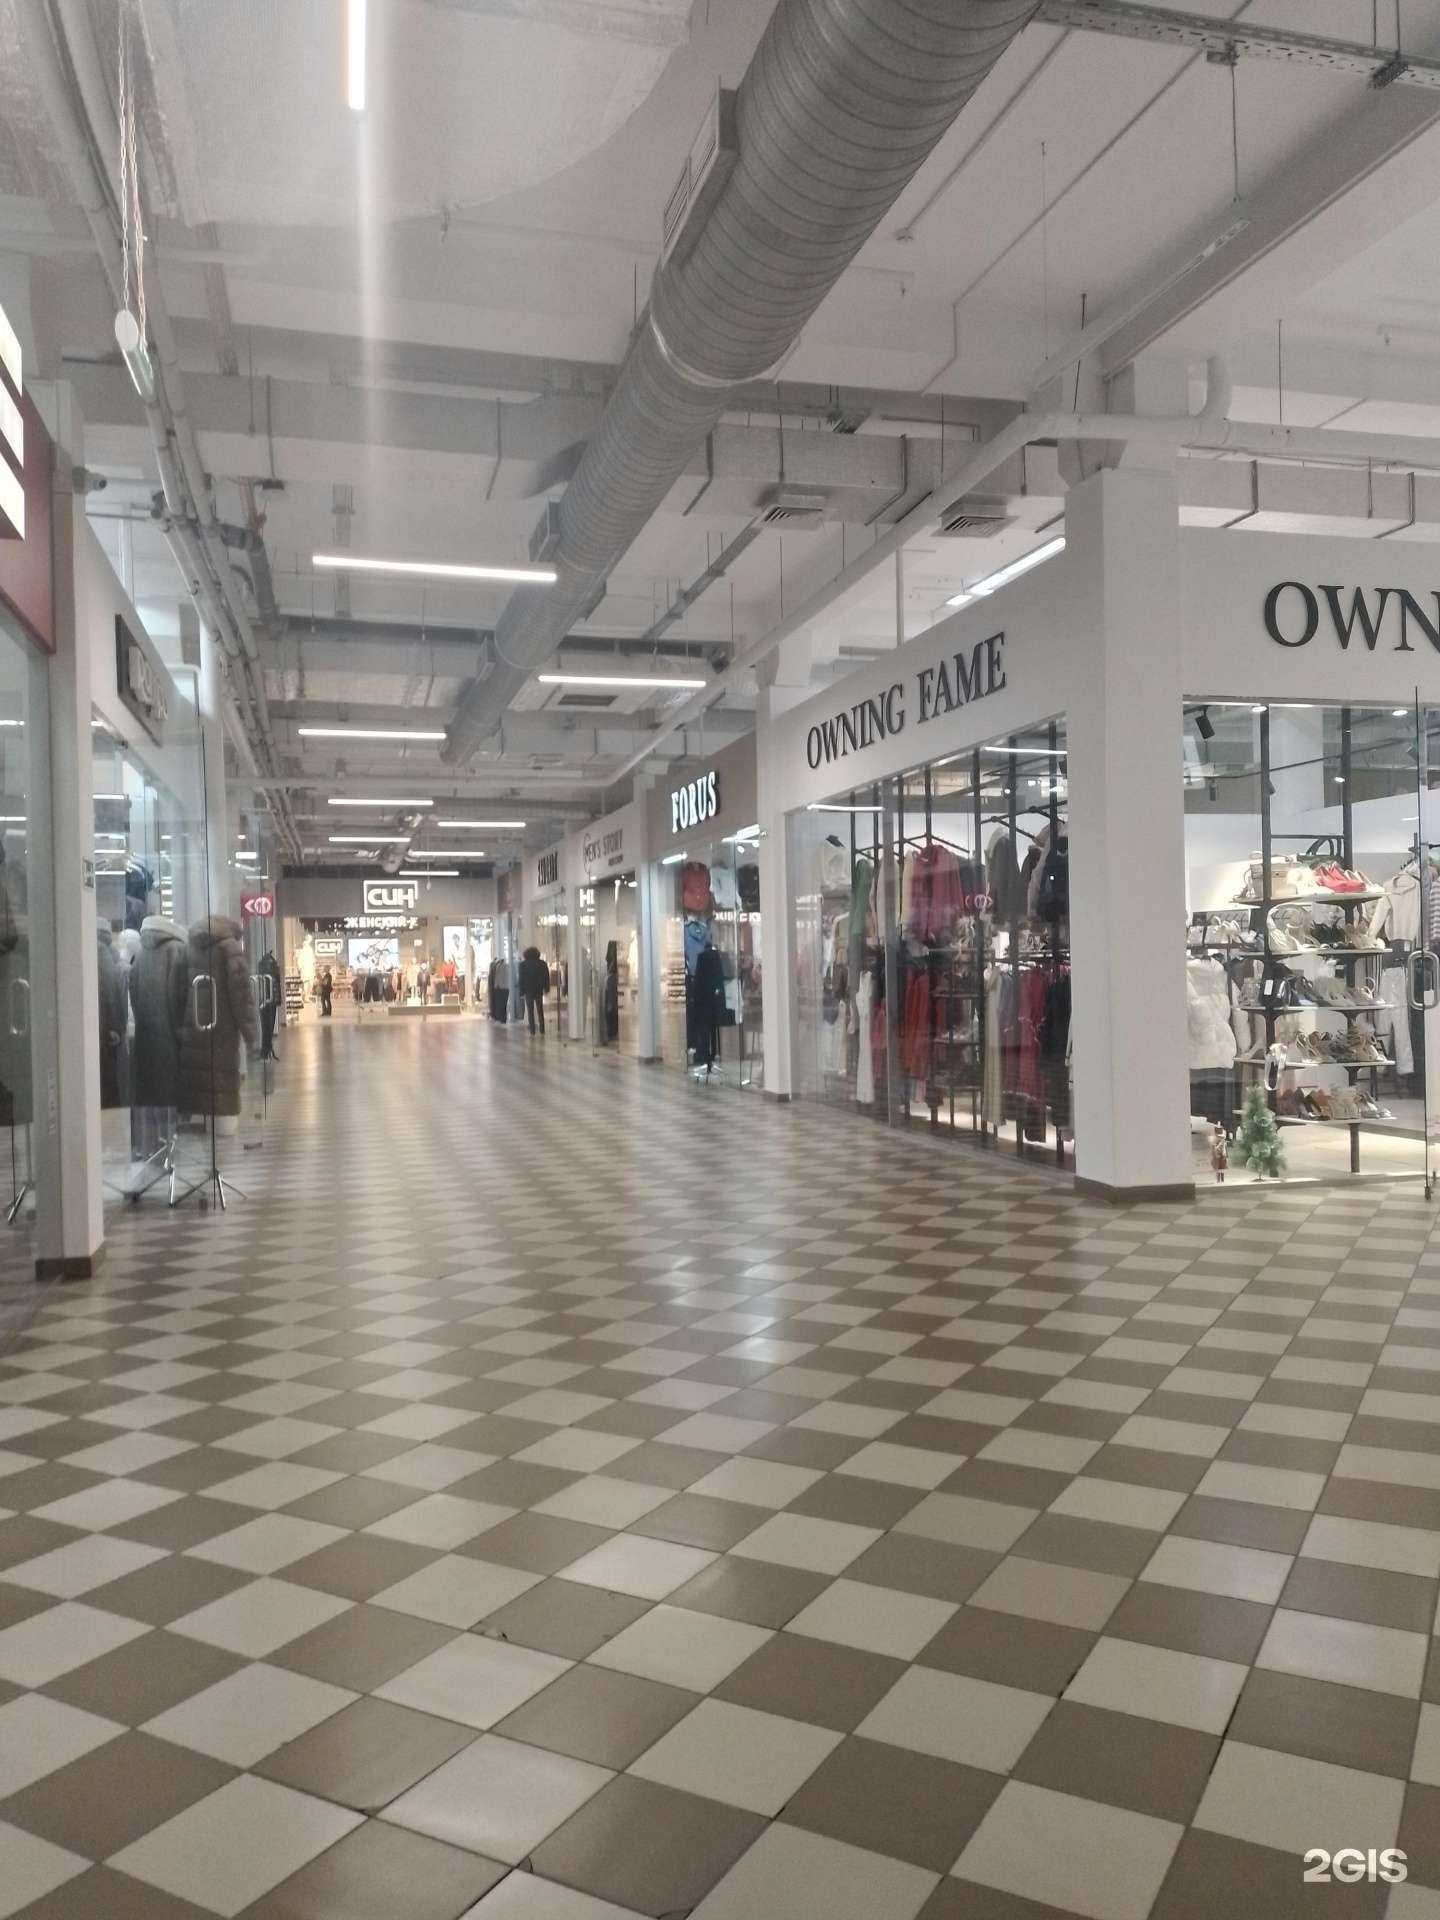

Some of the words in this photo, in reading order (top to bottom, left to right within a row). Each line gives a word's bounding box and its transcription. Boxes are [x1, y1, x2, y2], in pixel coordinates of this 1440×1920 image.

[1264, 581, 1440, 654] OWN
[806, 683, 904, 769] OWNING
[916, 631, 1006, 724] FAME
[671, 771, 718, 834] FORUS
